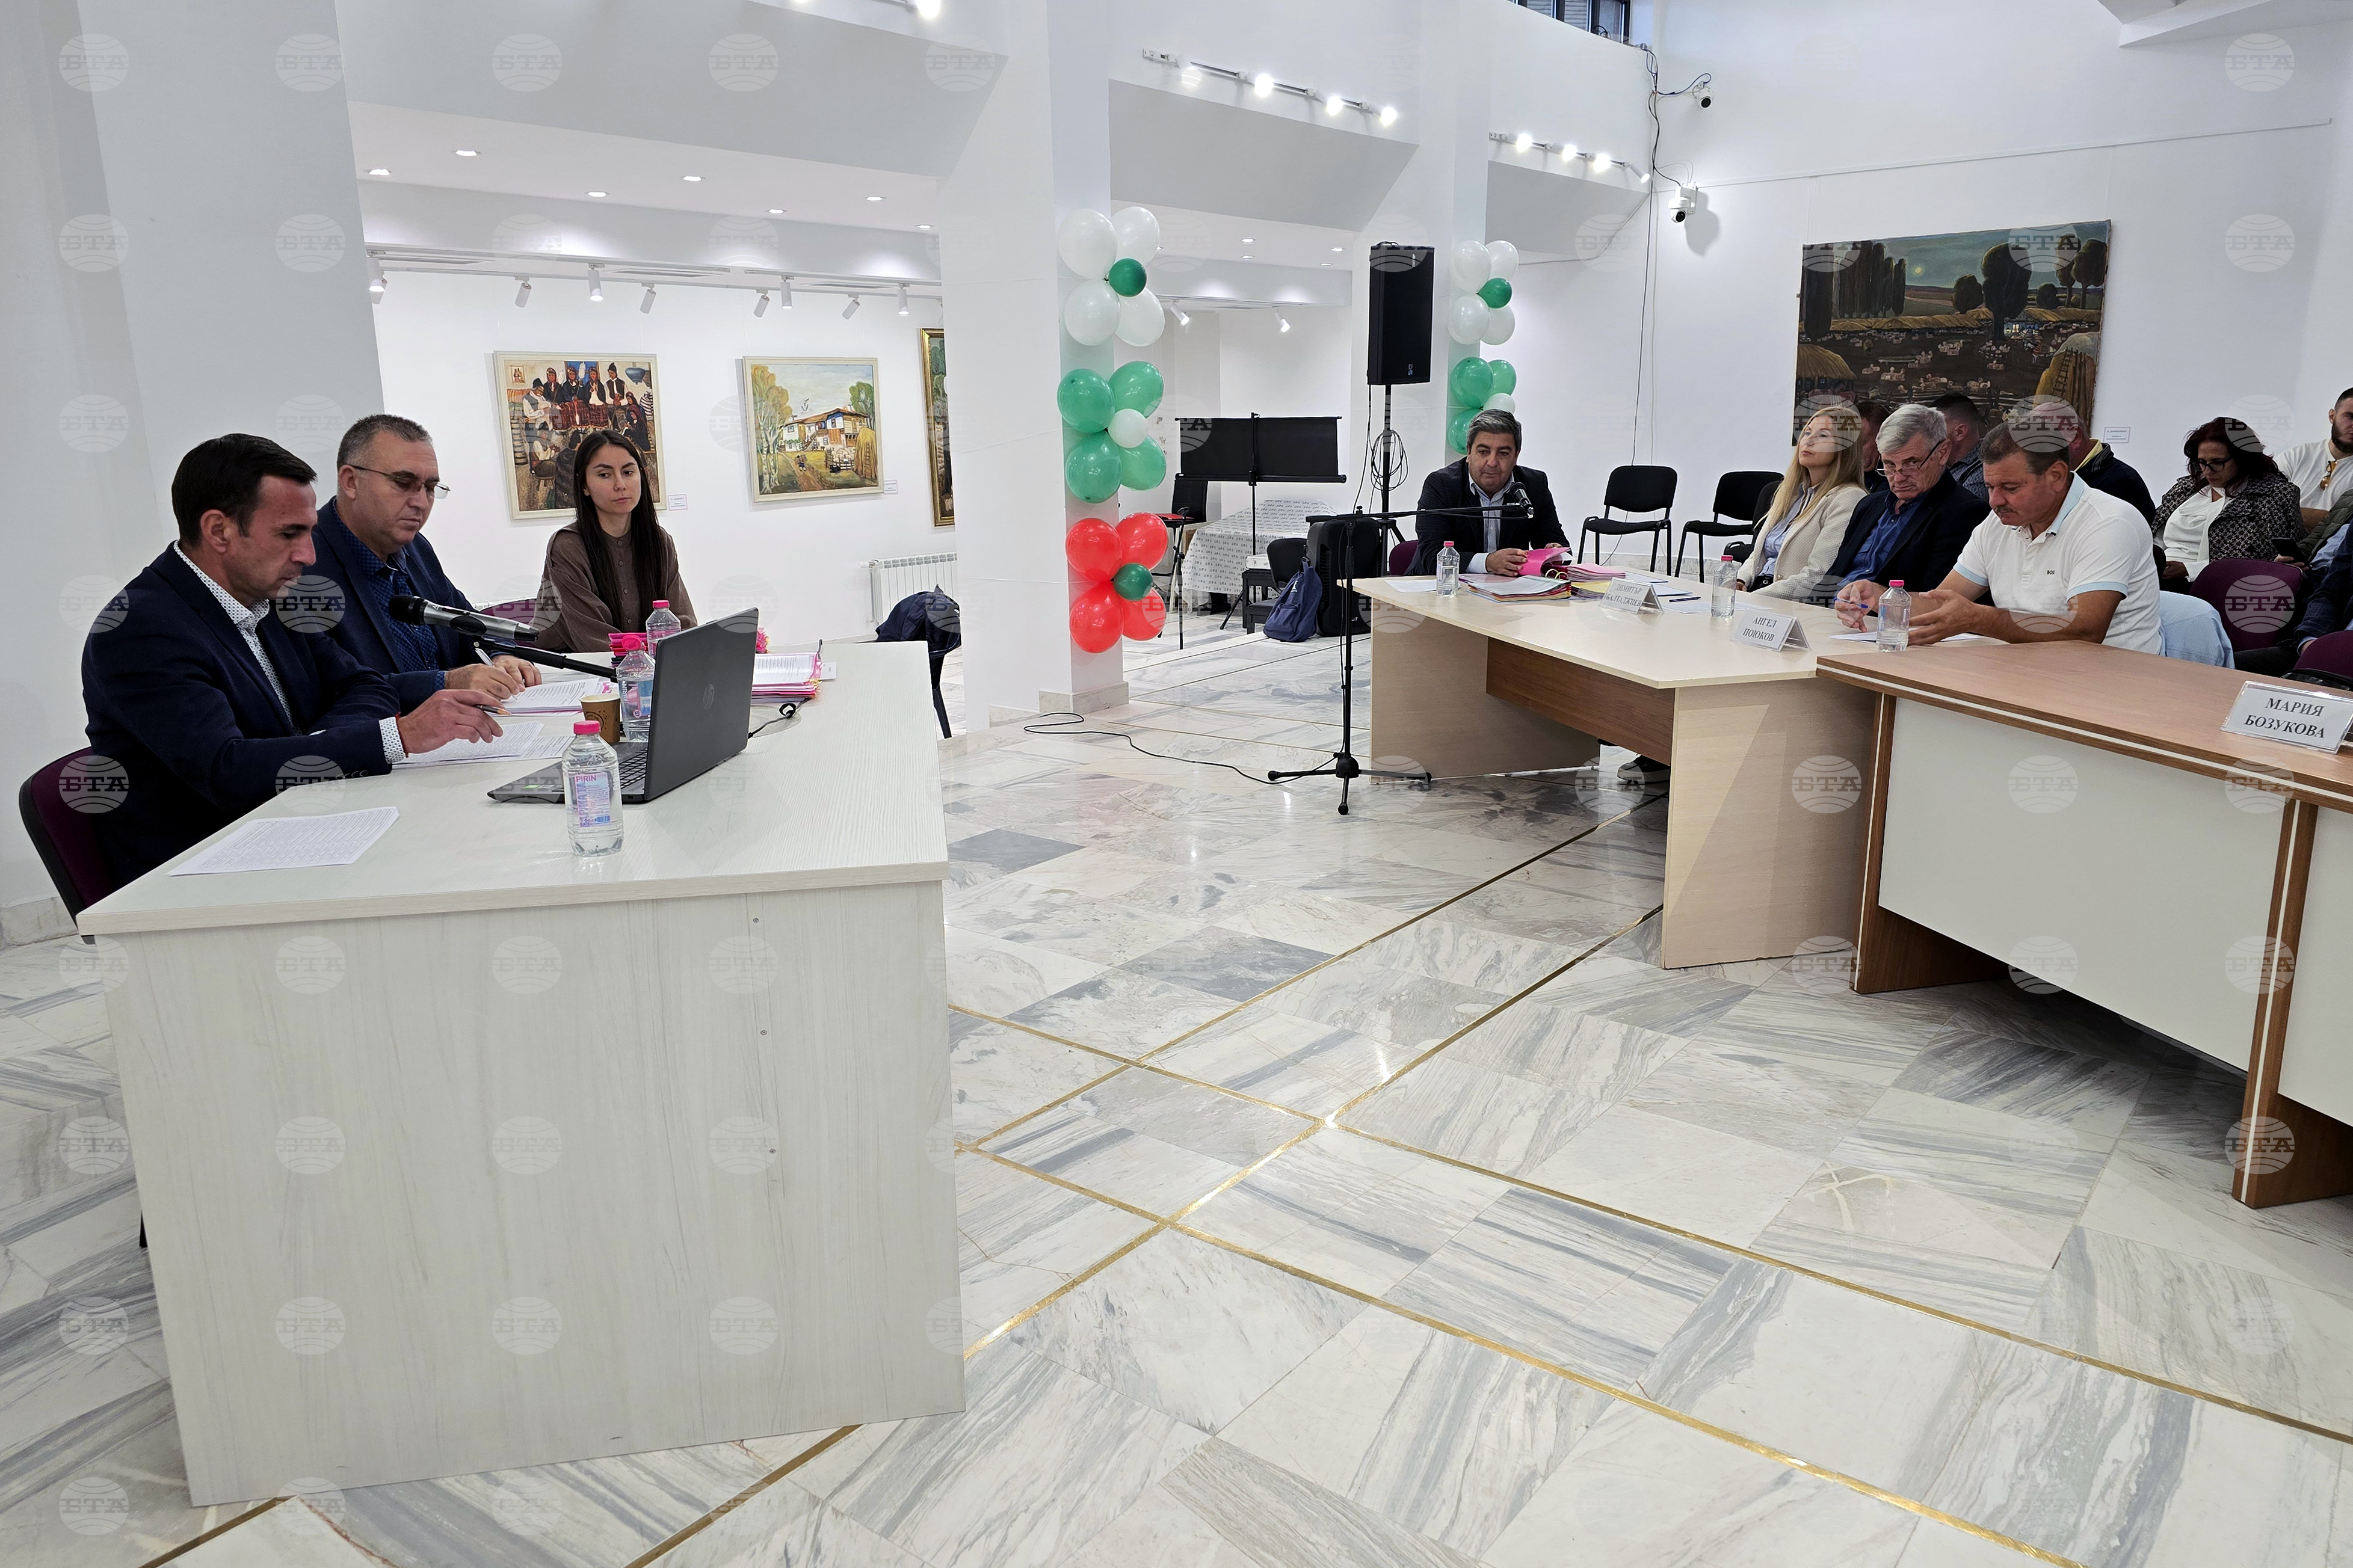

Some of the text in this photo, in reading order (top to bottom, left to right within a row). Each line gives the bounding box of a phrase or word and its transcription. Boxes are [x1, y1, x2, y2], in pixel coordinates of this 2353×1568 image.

[1615, 584, 1642, 594] ДИМИТЪР
[1753, 617, 1777, 627] АНГЕЛ
[1743, 629, 1774, 641] ПОЮКОВ
[2265, 698, 2325, 716] МАРИЯ
[2244, 715, 2324, 738] БОЗУКОВА
